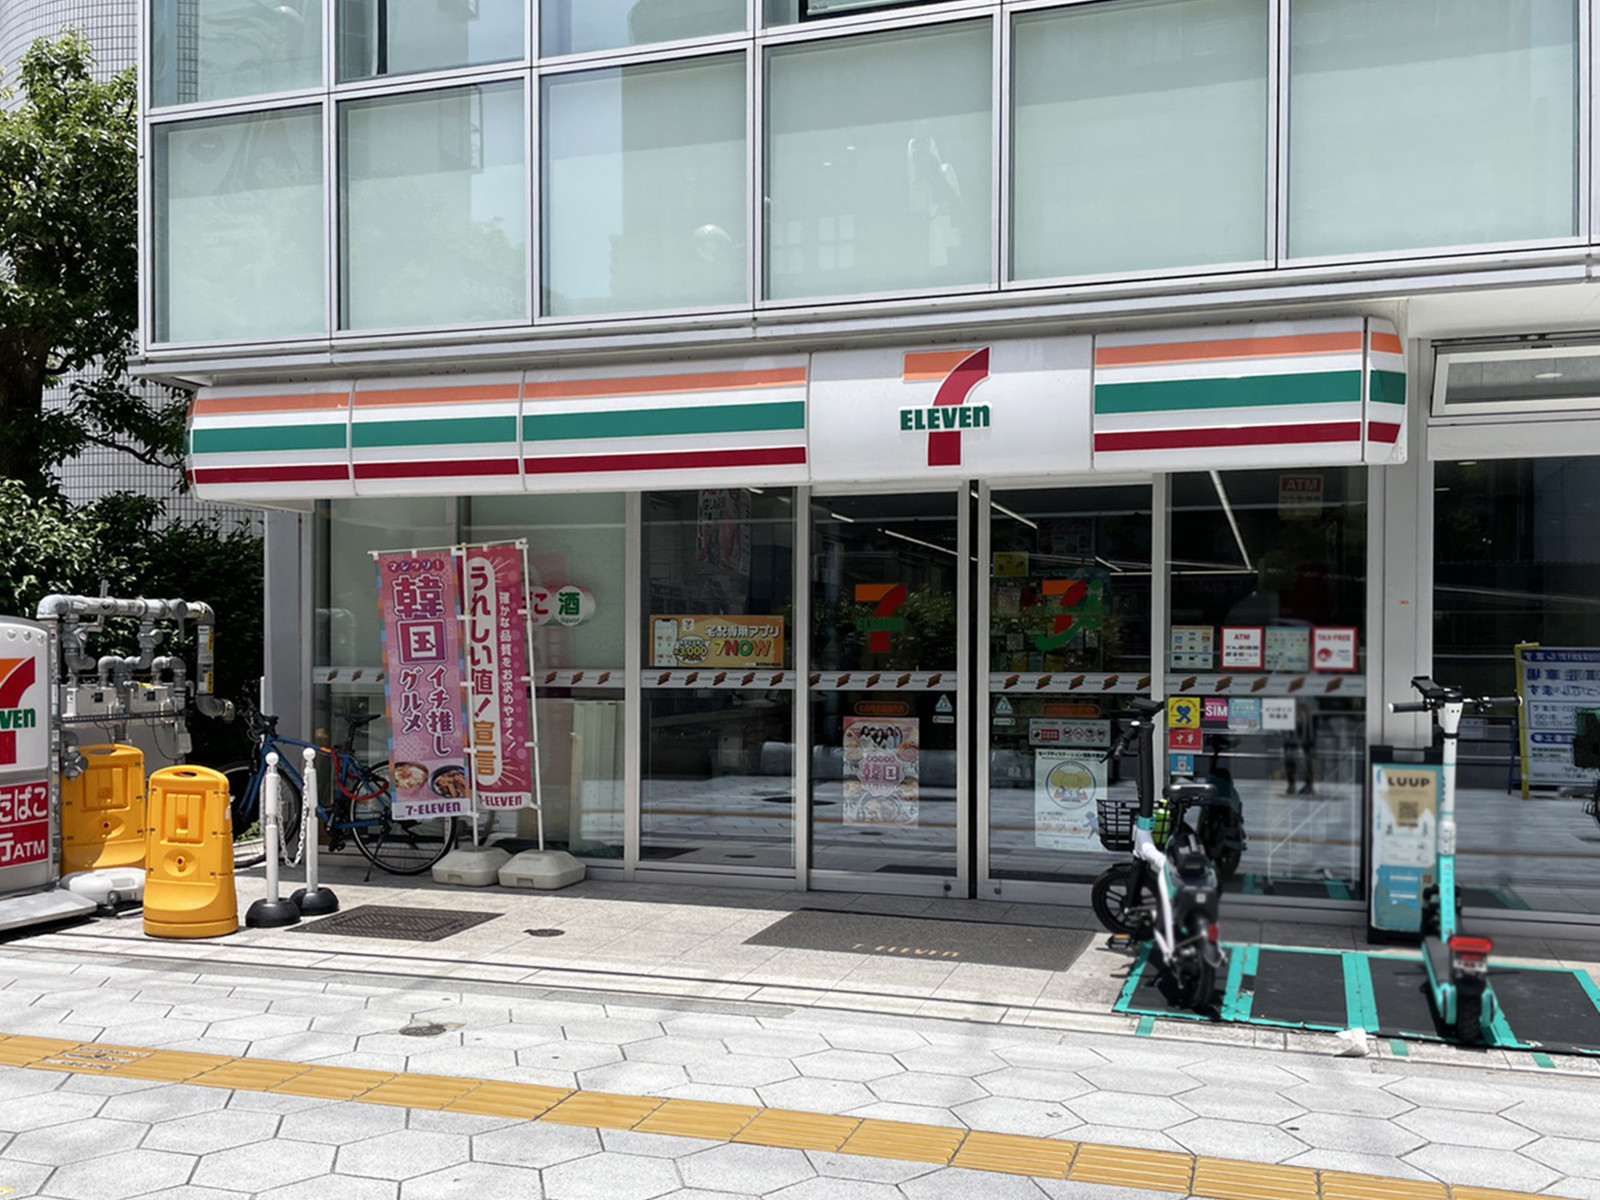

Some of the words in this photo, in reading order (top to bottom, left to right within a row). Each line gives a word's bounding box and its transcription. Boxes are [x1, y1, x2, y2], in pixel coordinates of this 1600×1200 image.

[904, 346, 990, 467] 7
[1286, 479, 1318, 491] ATM
[558, 592, 581, 615] 酒
[392, 574, 447, 663] 韓国
[714, 640, 771, 657] 7NOW
[400, 667, 423, 733] グルメ
[428, 665, 453, 756] イチ推し
[1205, 705, 1228, 717] SIM
[1388, 776, 1431, 788] LUUP
